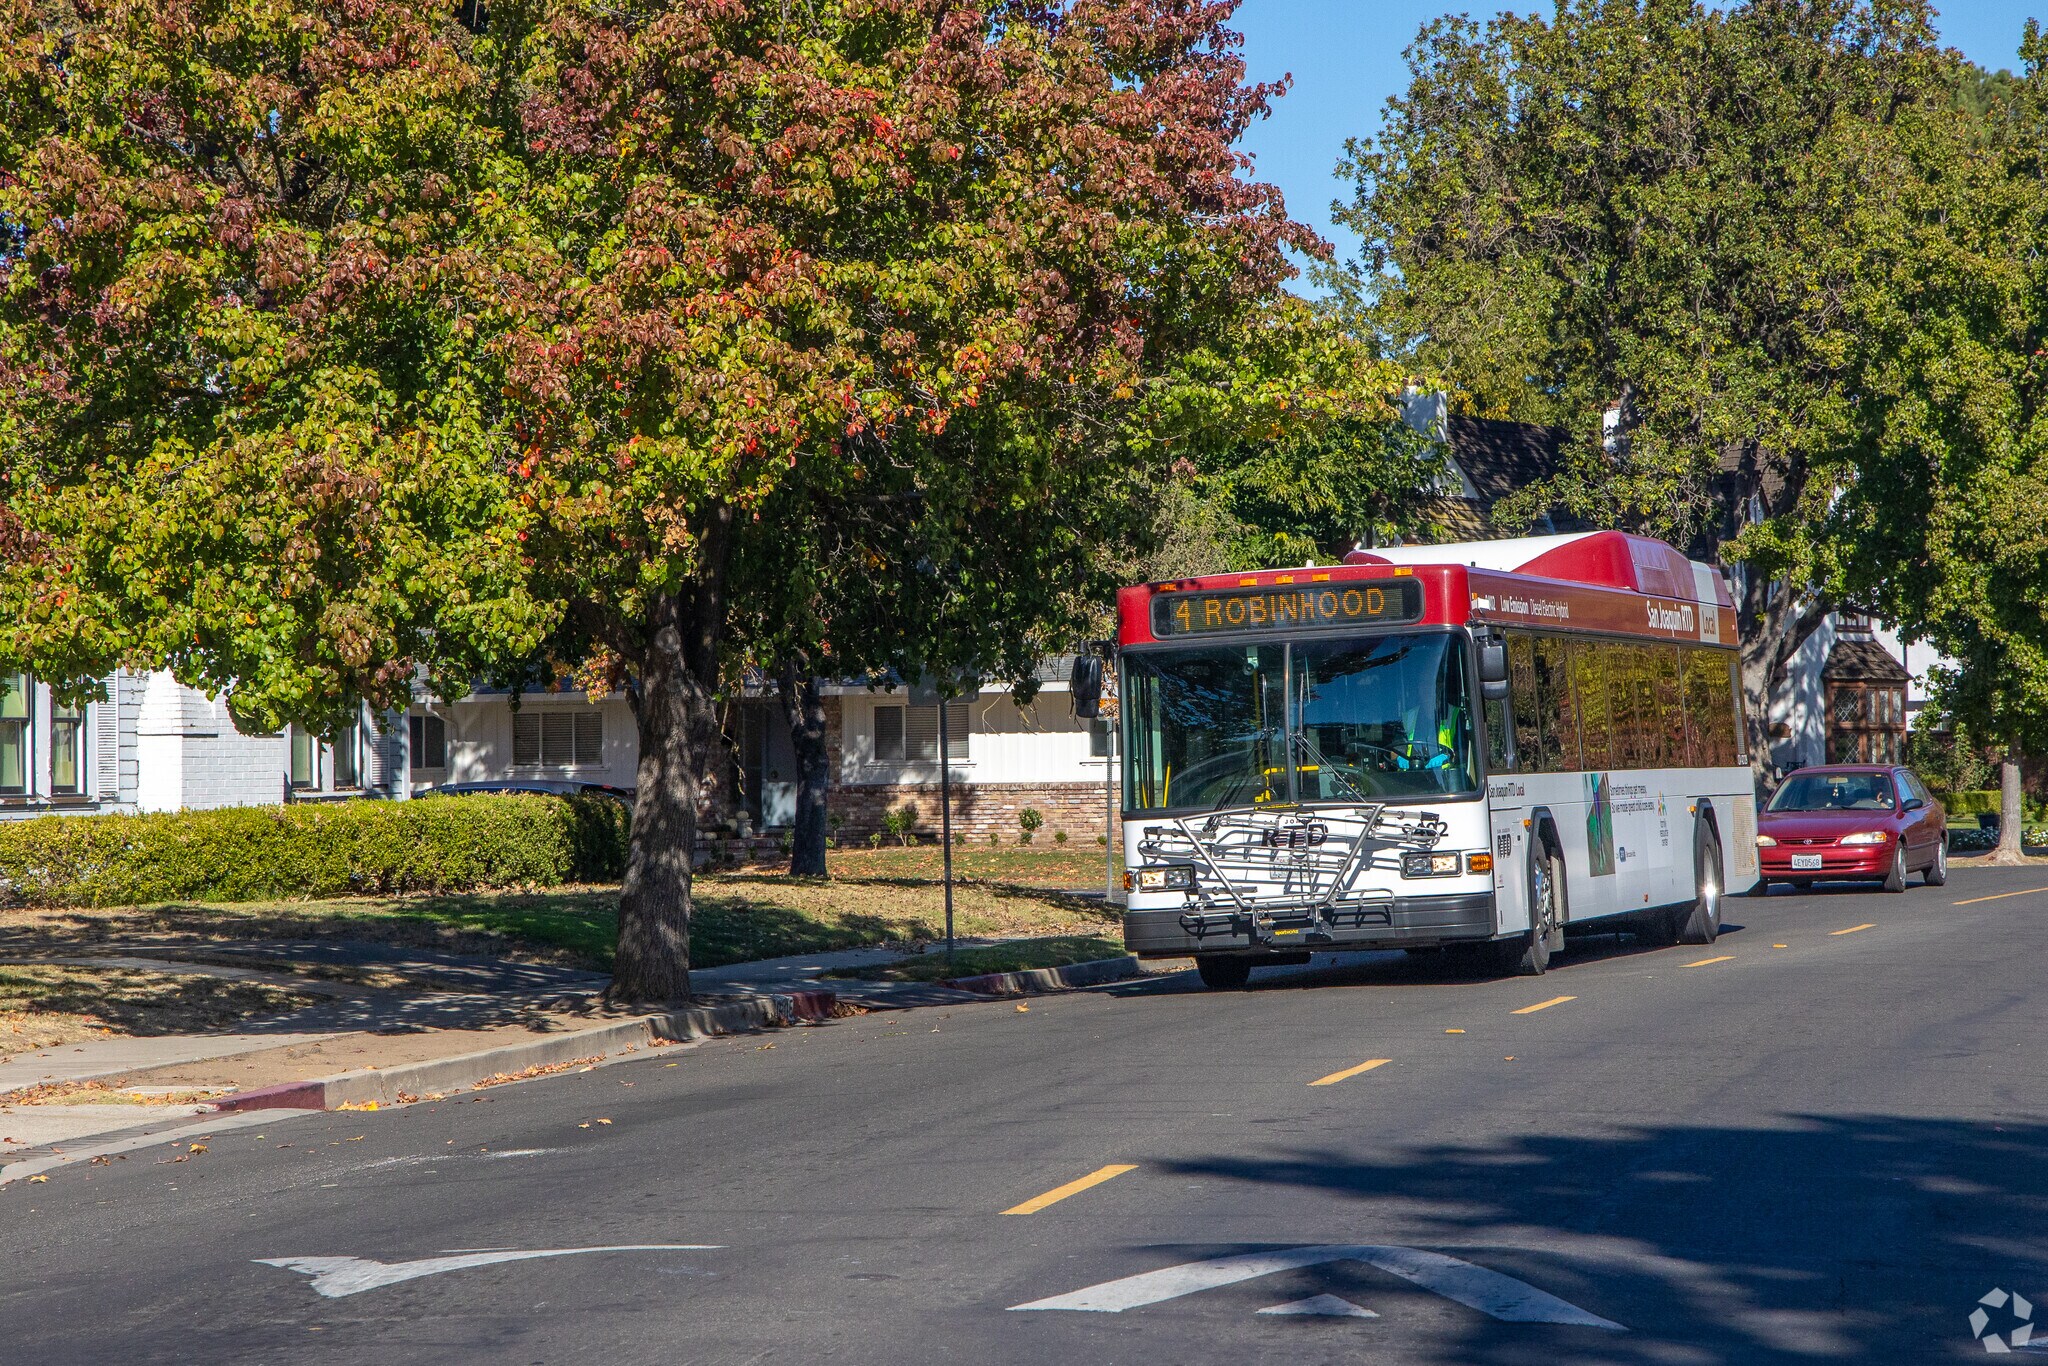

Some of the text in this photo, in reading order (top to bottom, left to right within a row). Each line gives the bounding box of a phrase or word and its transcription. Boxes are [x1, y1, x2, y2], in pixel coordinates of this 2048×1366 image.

[1176, 588, 1386, 631] 4 ROBINHOOD
[1500, 595, 1510, 613] Low
[1509, 596, 1529, 614] Emission
[1530, 598, 1570, 622] Diesel Electric Hybrid
[1646, 600, 1694, 637] San Joaquin RTD
[1702, 610, 1717, 635] Local
[1495, 783, 1508, 801] Joaquin
[1516, 782, 1525, 796] Local
[1262, 824, 1328, 848] RTD
